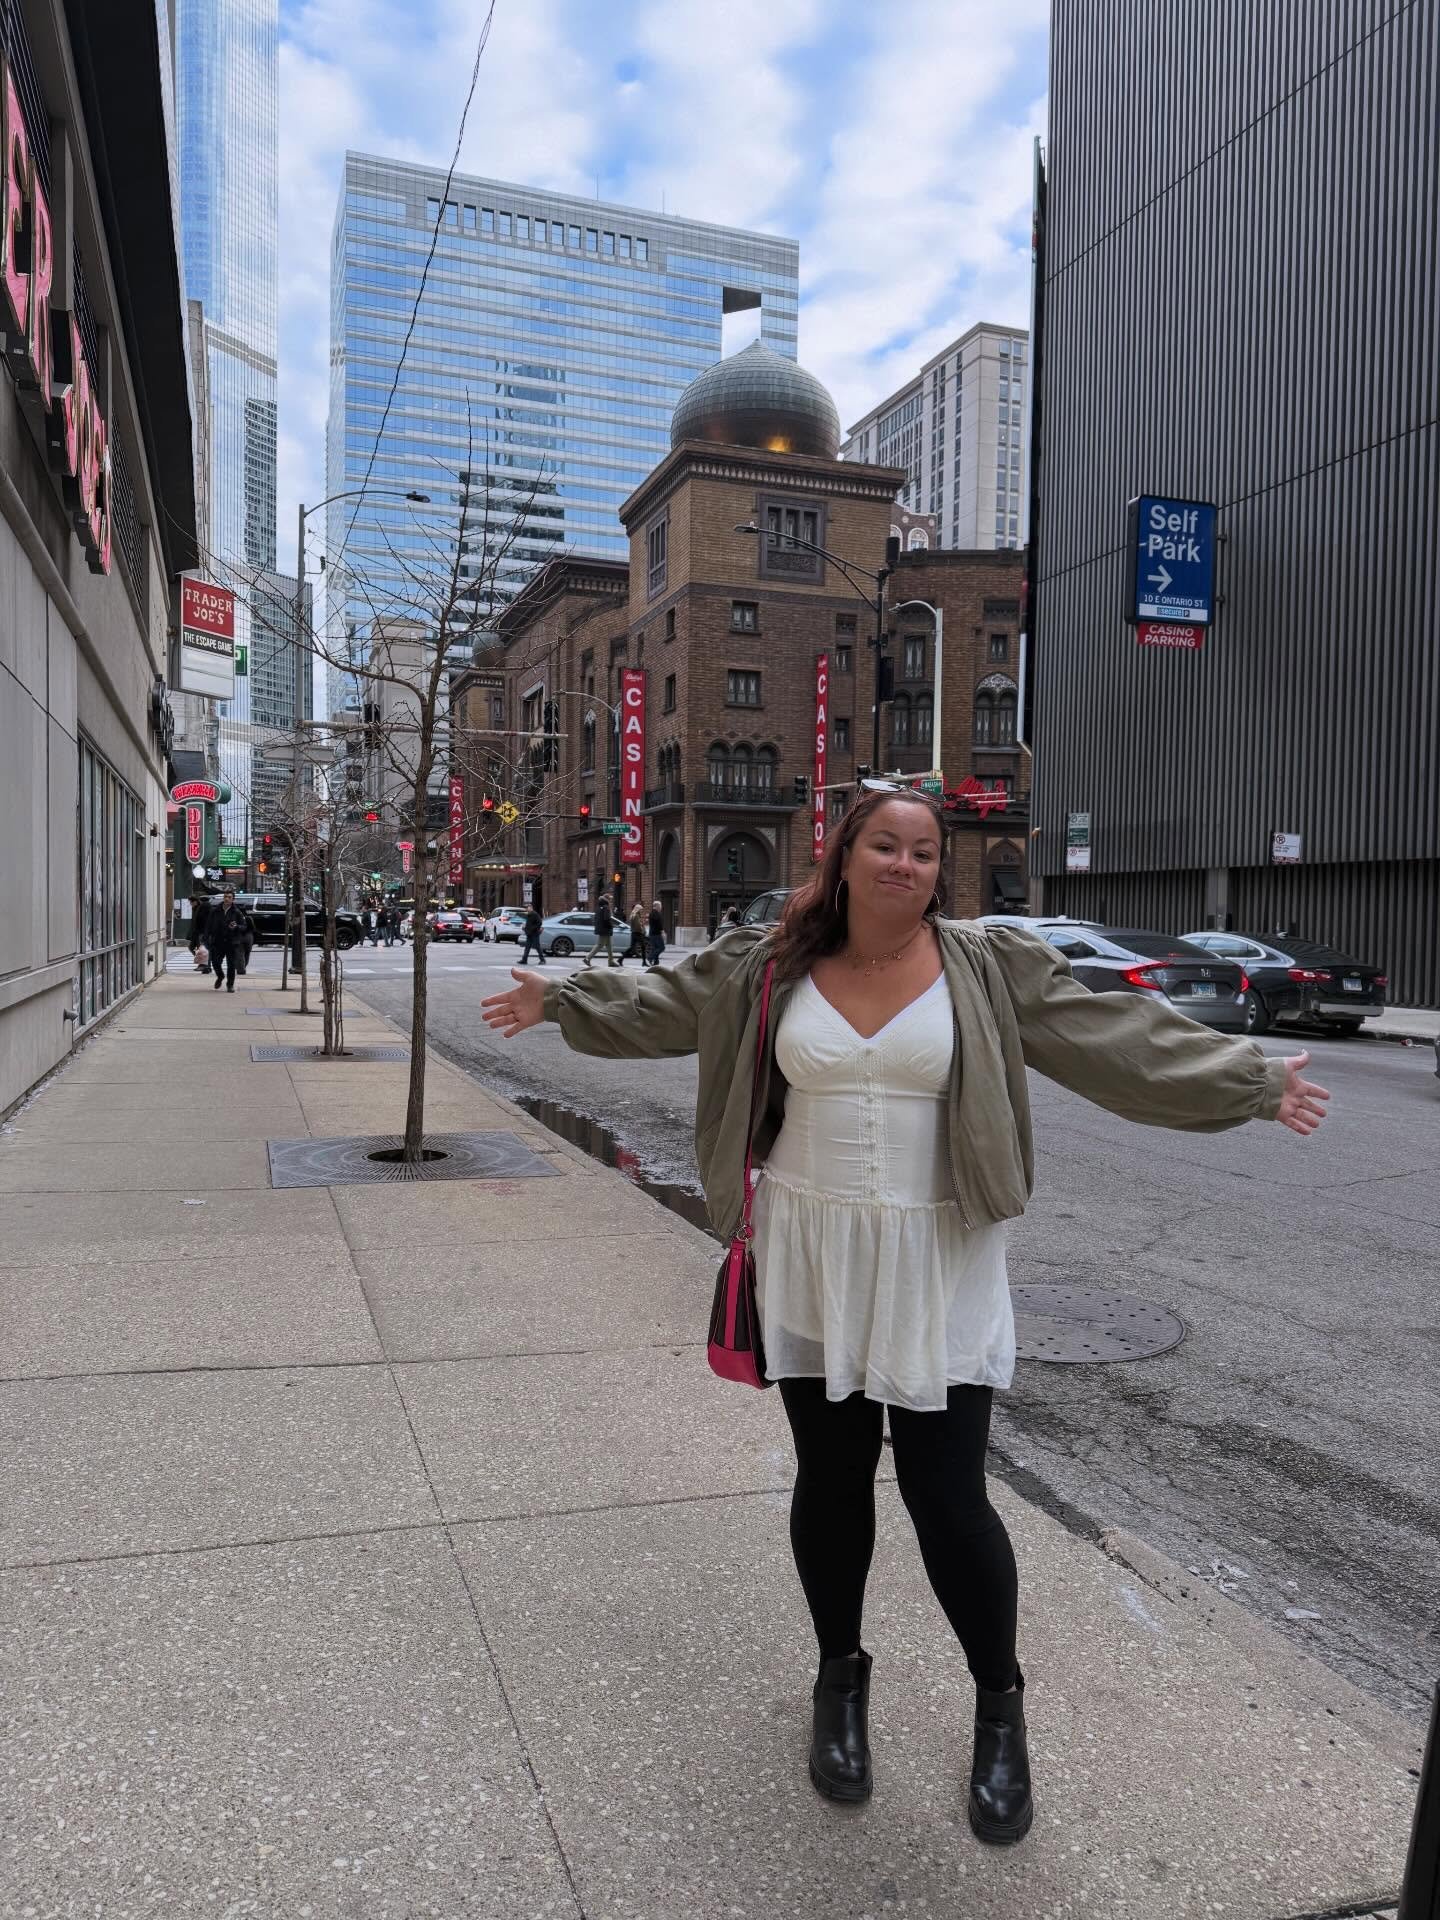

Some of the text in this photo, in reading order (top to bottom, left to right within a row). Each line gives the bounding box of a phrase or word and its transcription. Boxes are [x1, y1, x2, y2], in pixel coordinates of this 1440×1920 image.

[1149, 504, 1198, 534] Self
[1148, 533, 1201, 563] Park
[184, 587, 233, 613] TRADER
[1144, 594, 1204, 607] 10 E ONTARIO ST
[193, 606, 225, 625] JOE'S
[184, 631, 233, 654] THE ESCAPE GAME
[1144, 634, 1196, 647] PARKING
[1149, 624, 1194, 637] CASINO
[625, 687, 642, 844] CASINO
[815, 673, 827, 842] CASINO
[188, 807, 202, 859] DUE
